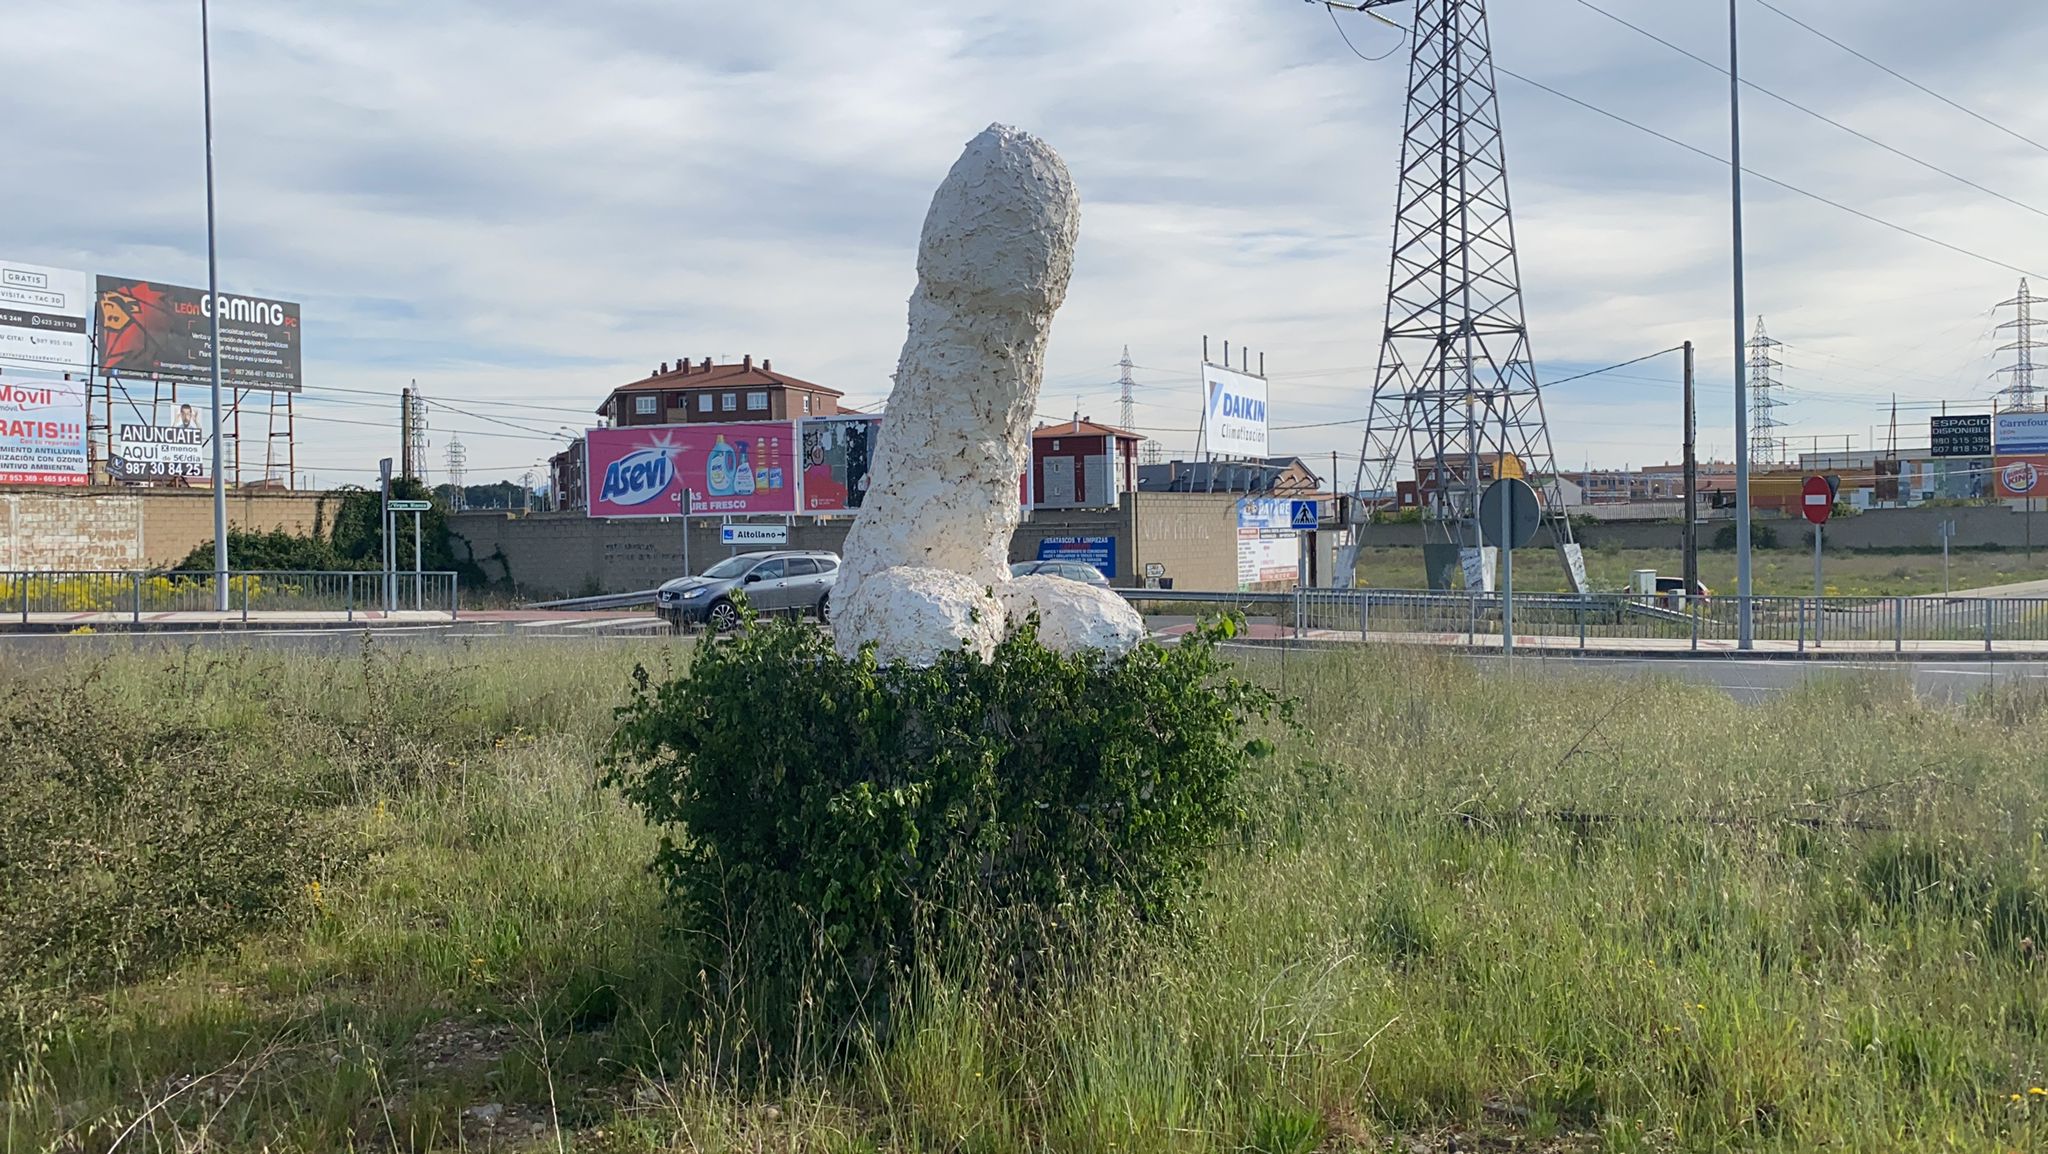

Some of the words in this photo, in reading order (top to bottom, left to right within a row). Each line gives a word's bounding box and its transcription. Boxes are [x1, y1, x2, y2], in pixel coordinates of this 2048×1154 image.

[8, 273, 41, 284] GRATIS
[1, 290, 25, 299] VISITA
[35, 295, 49, 303] TAC
[1223, 392, 1265, 422] DAIKIN
[1932, 418, 1990, 427] ESPACIO
[1999, 418, 2048, 428] Carrefour
[122, 425, 201, 444] ANUNCIATE
[1221, 423, 1265, 443] Climatización
[1932, 426, 1990, 435] DISPONIBLE
[35, 447, 81, 455] ANTILLUVIA
[123, 444, 159, 460] AQUÍ
[1972, 444, 1990, 452] 579
[31, 463, 76, 471] AMBIENTAL
[125, 462, 146, 475] 987
[150, 462, 165, 475] 30
[168, 463, 183, 476] 84
[186, 463, 201, 476] 25
[600, 450, 667, 499] Asevi
[709, 500, 747, 511] FRESCO
[737, 530, 776, 538] Altollano
[1082, 536, 1109, 544] LIMPIEZAS
